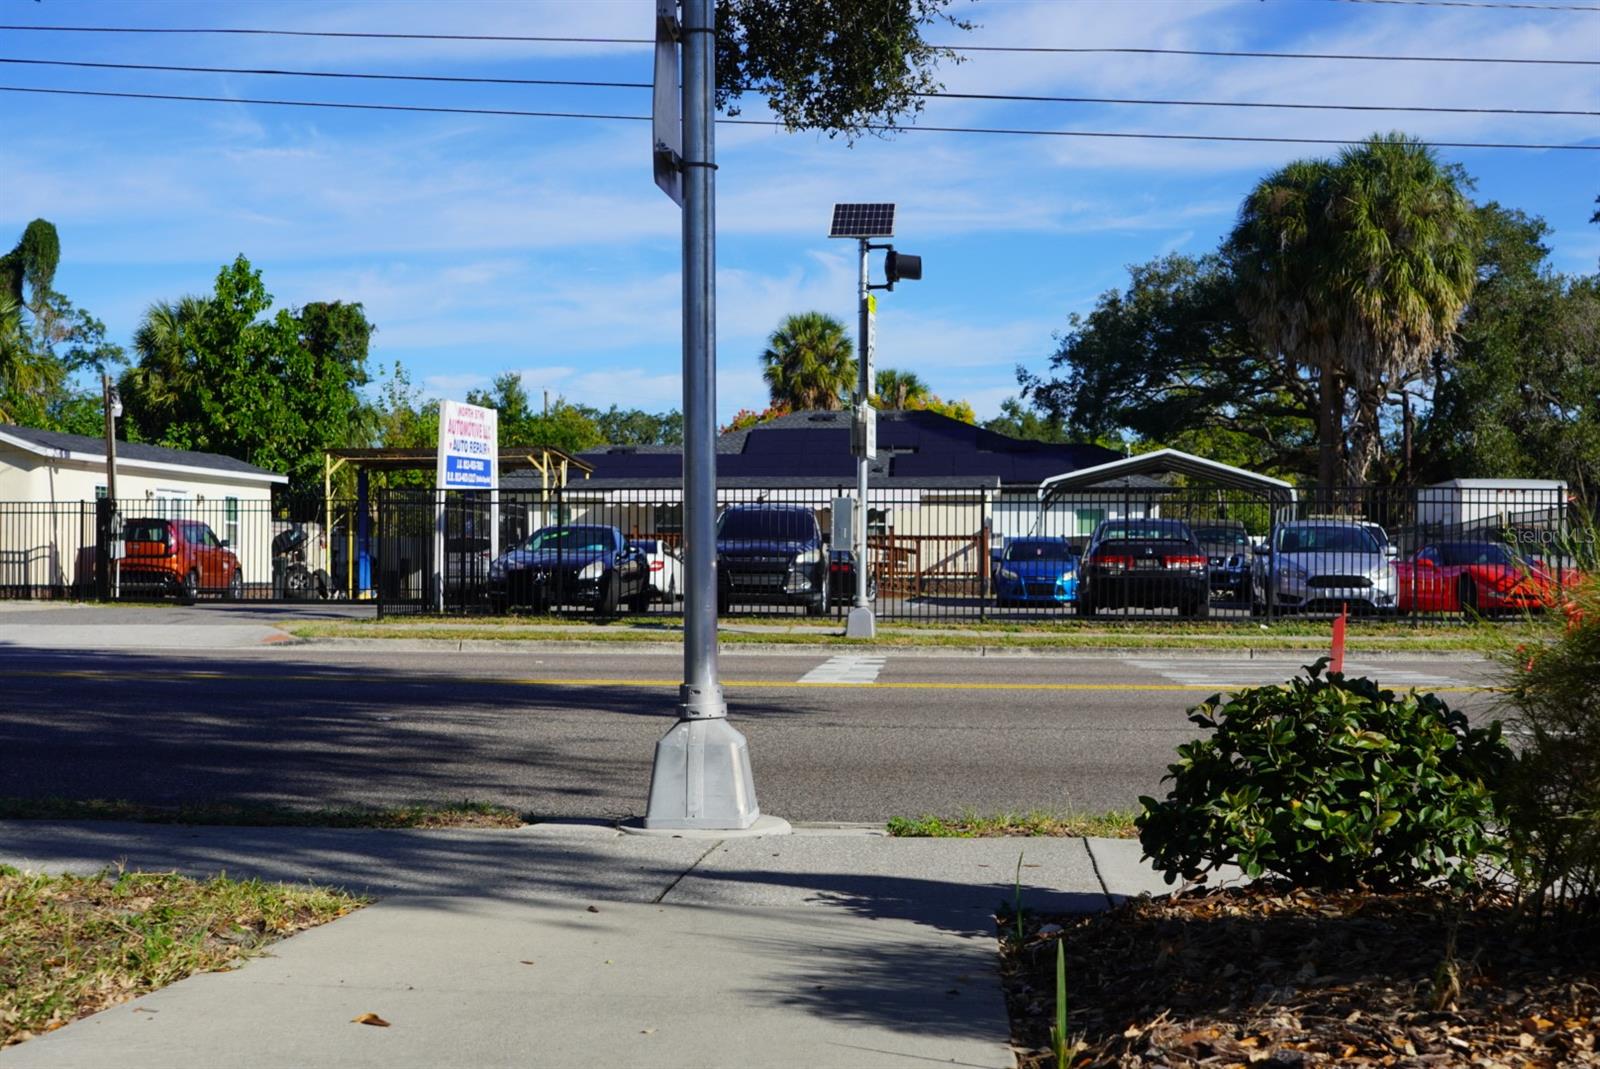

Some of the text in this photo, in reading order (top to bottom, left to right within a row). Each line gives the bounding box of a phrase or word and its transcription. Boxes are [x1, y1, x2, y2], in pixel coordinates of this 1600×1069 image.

[448, 418, 482, 438] AUTOMOTIVE
[453, 437, 487, 455] AUTO REPAIR
